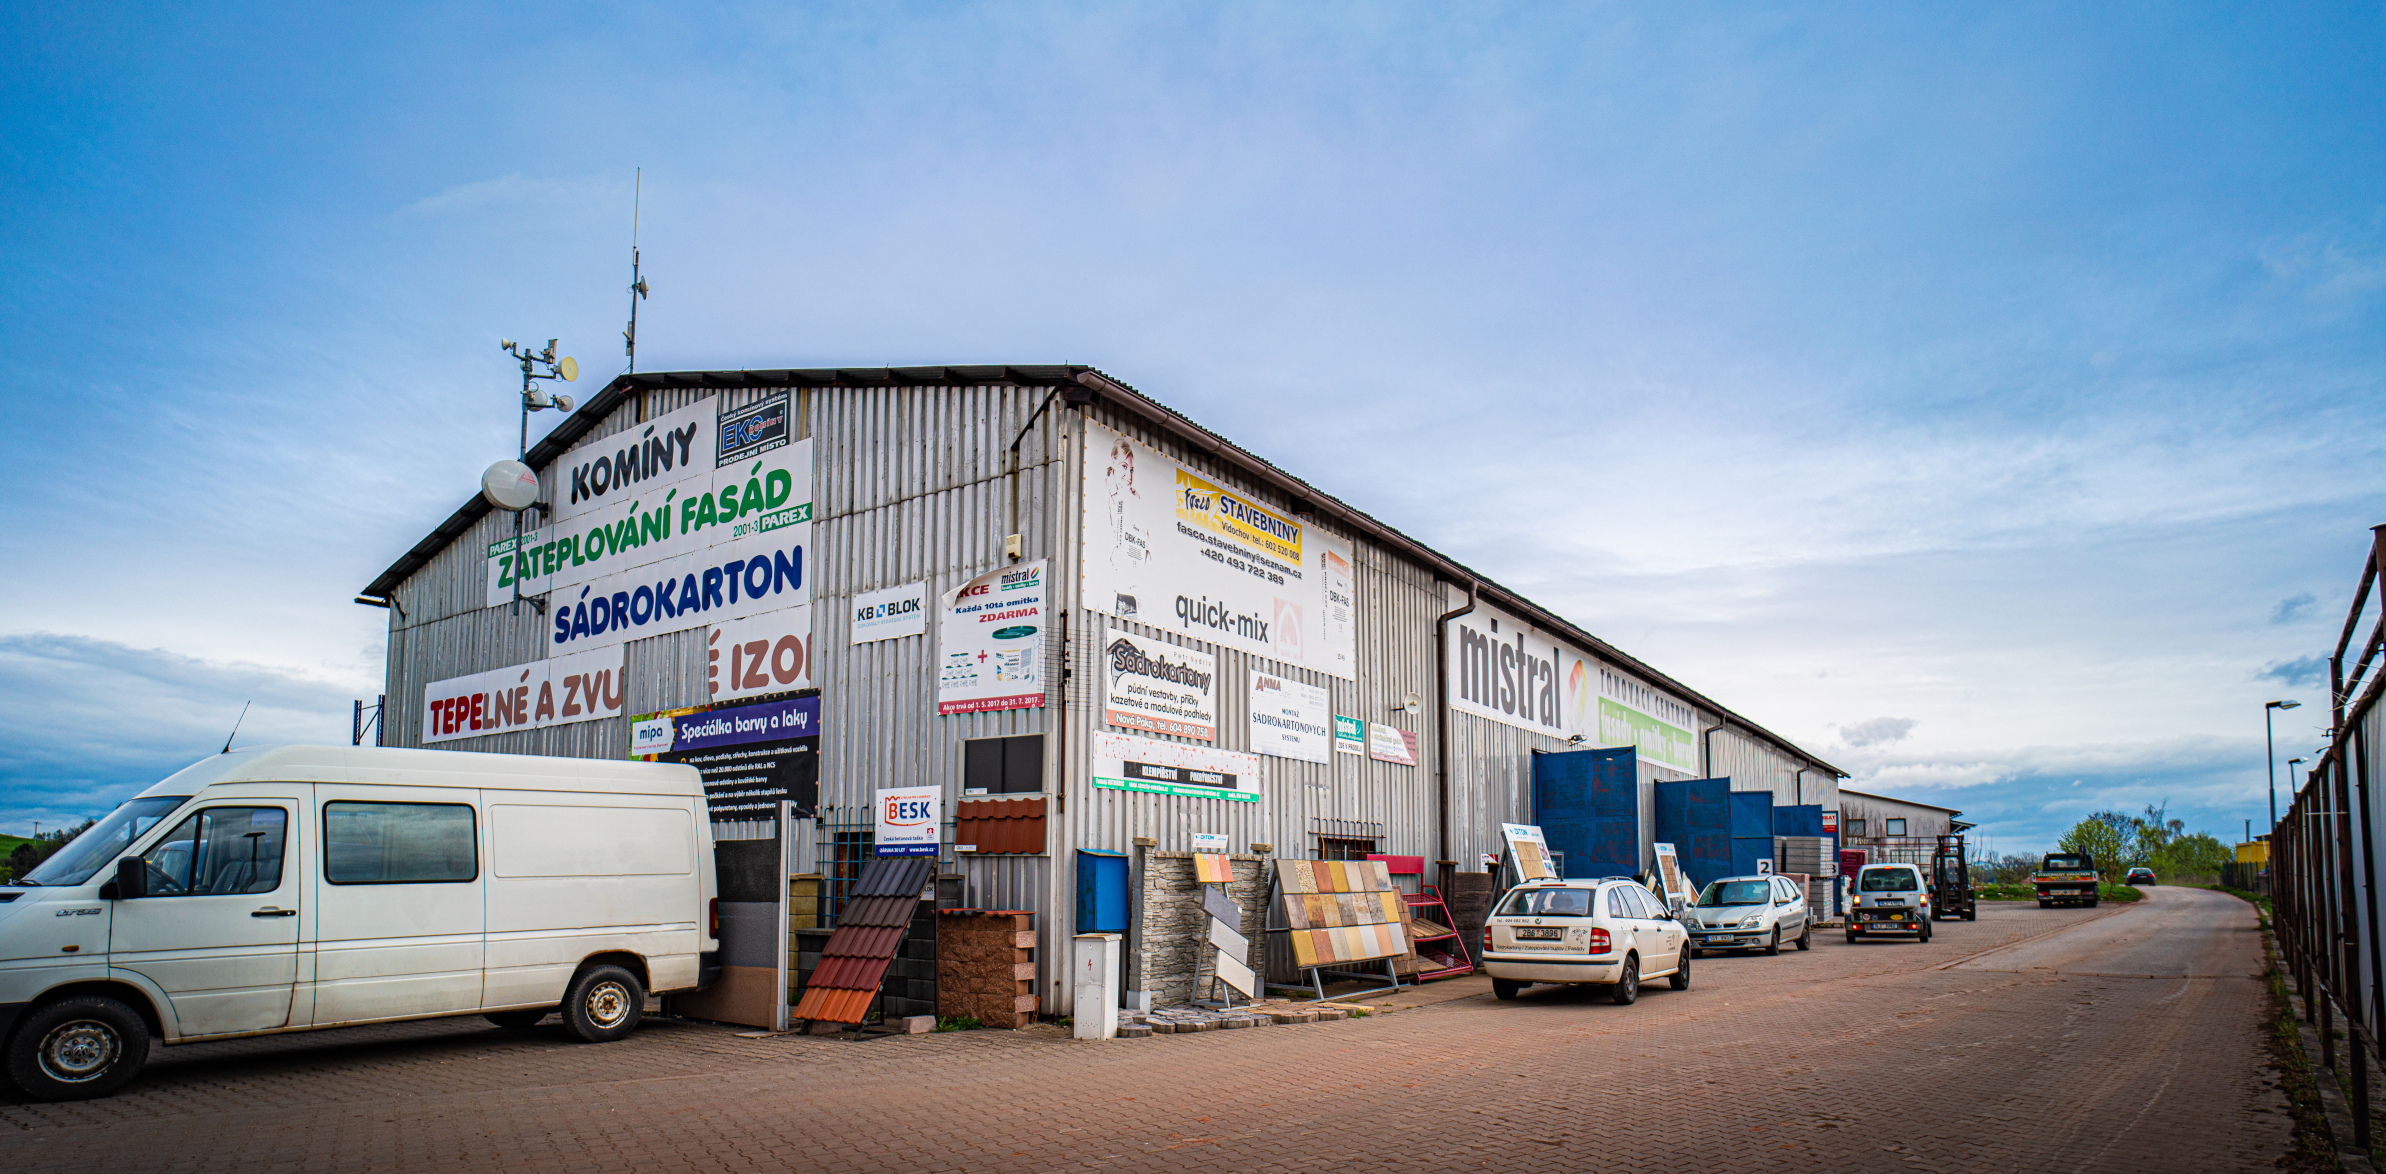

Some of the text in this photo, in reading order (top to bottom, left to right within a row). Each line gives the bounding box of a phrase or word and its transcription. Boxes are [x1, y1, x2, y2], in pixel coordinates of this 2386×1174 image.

[571, 421, 698, 505] KOMÍNY
[719, 439, 787, 467] PRODEJNÍ MÍSTO
[498, 460, 793, 589] ZATEPLOVÁNÍ FASÁD
[733, 520, 759, 537] 2001-3
[760, 504, 810, 531] PAREX
[1220, 495, 1299, 544] STAVEBNINY
[489, 539, 517, 556] PAREX
[1176, 521, 1302, 579] fasco.stavebniny@seznam.cz
[1221, 521, 1300, 561] Vidochov tel.: 602 520 008
[1001, 567, 1029, 584] mistral
[1200, 548, 1284, 585] +420 493 722 389
[554, 544, 803, 644] SÁDROKARTON
[955, 596, 1039, 614] Každá 10tá omítka
[857, 597, 921, 621] KB BLOK
[979, 607, 1038, 623] ZDARMA
[1175, 594, 1269, 644] quick-mix
[731, 632, 812, 691] IZO
[1114, 645, 1211, 696] Sádrokartony
[1460, 617, 1561, 729] mistral
[1127, 682, 1199, 708] půdní vestavby, příčky
[1255, 675, 1281, 692] ANMA
[430, 669, 529, 736] TEPELNÉ
[534, 680, 555, 722] A
[943, 703, 955, 711] Akce
[955, 702, 967, 710] trvá
[967, 701, 975, 709] od
[1110, 692, 1212, 723] kazetové a modulové podhledy
[1655, 695, 1692, 729] CENTRUM
[640, 725, 663, 742] mipa
[681, 708, 808, 743] Speciálka barvy a laky
[1116, 712, 1209, 738] Nová Paka, tel. 604 890 758
[1252, 710, 1326, 737] SÁDROKARTONOVÝCH
[888, 801, 931, 820] BESK
[1760, 861, 1770, 873] 2
